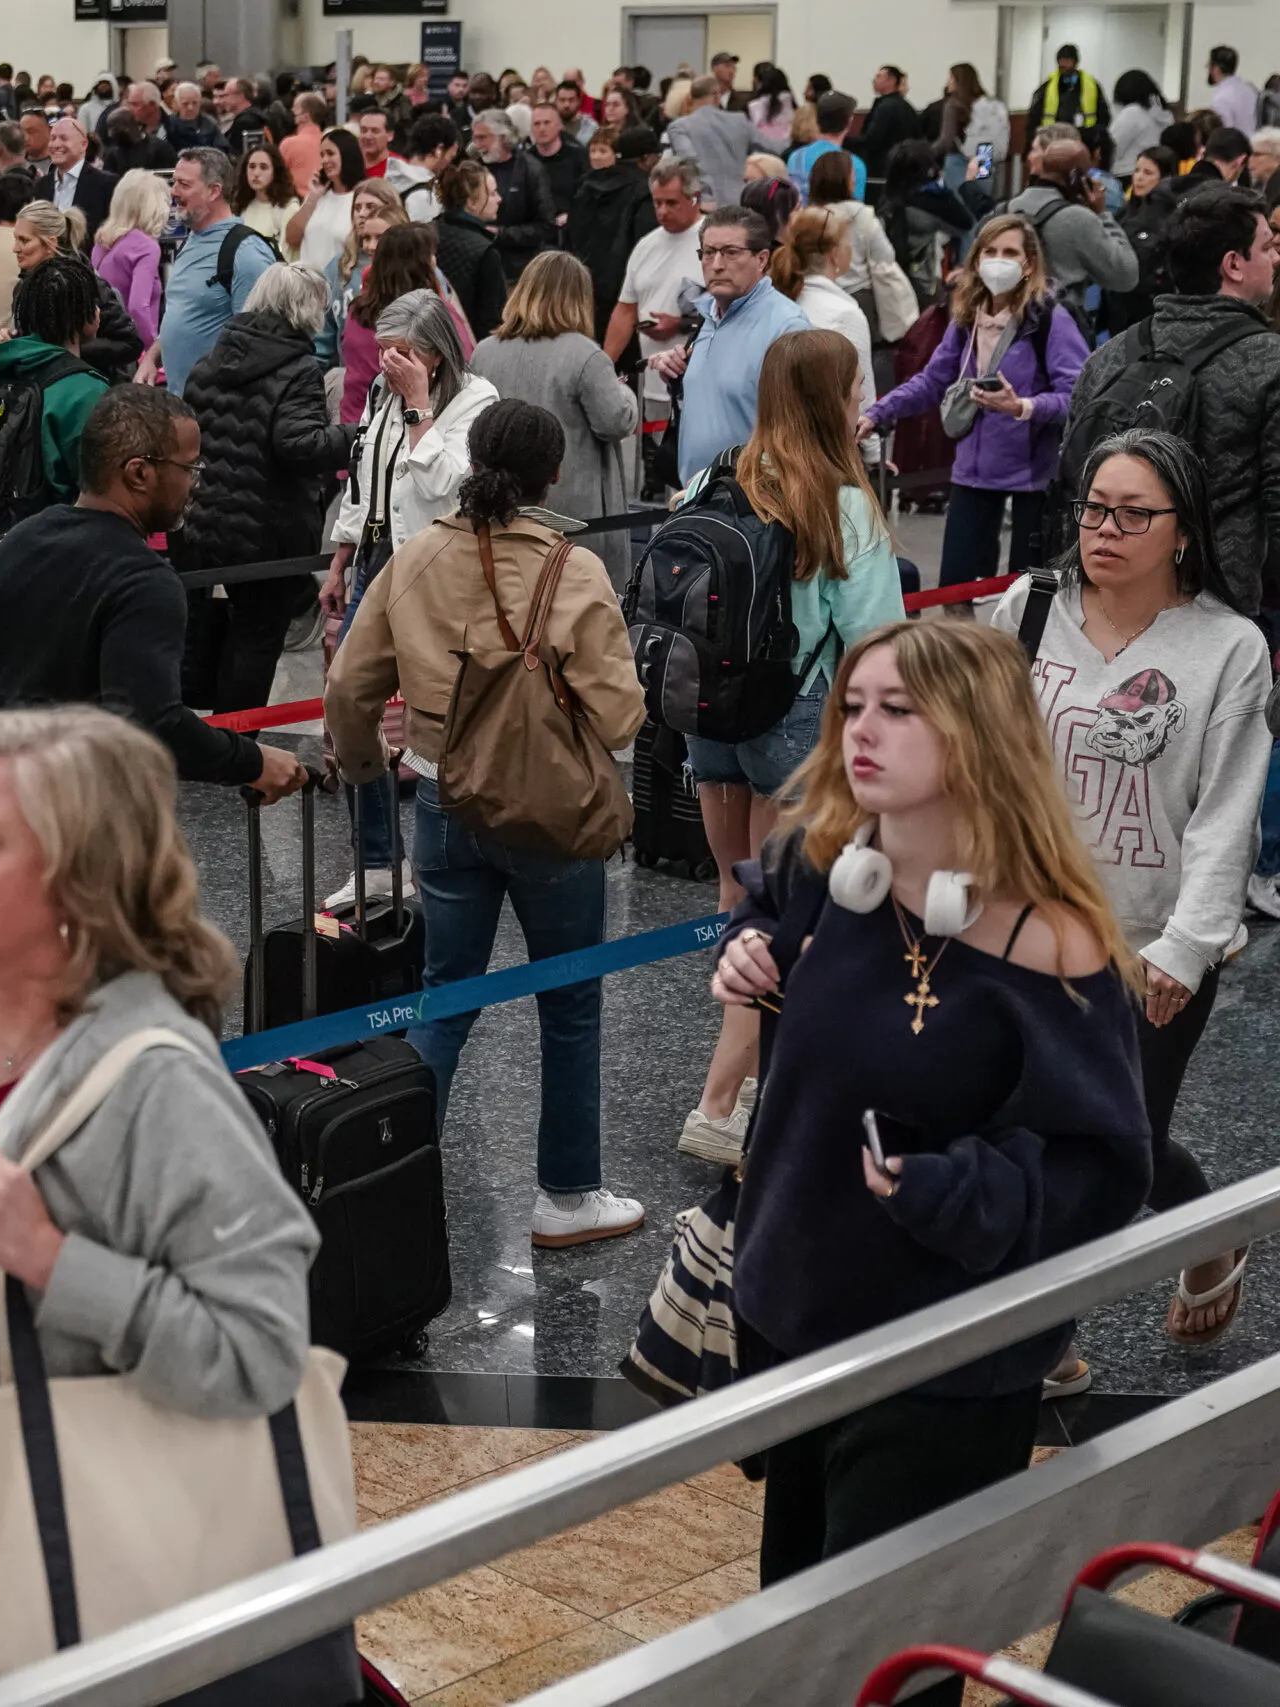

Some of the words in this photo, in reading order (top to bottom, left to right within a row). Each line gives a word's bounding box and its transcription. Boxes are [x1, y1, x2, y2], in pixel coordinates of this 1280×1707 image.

[693, 925, 716, 943] TSA
[715, 922, 727, 938] Pr
[366, 1010, 392, 1030] TSA
[392, 1006, 414, 1024] Pre
